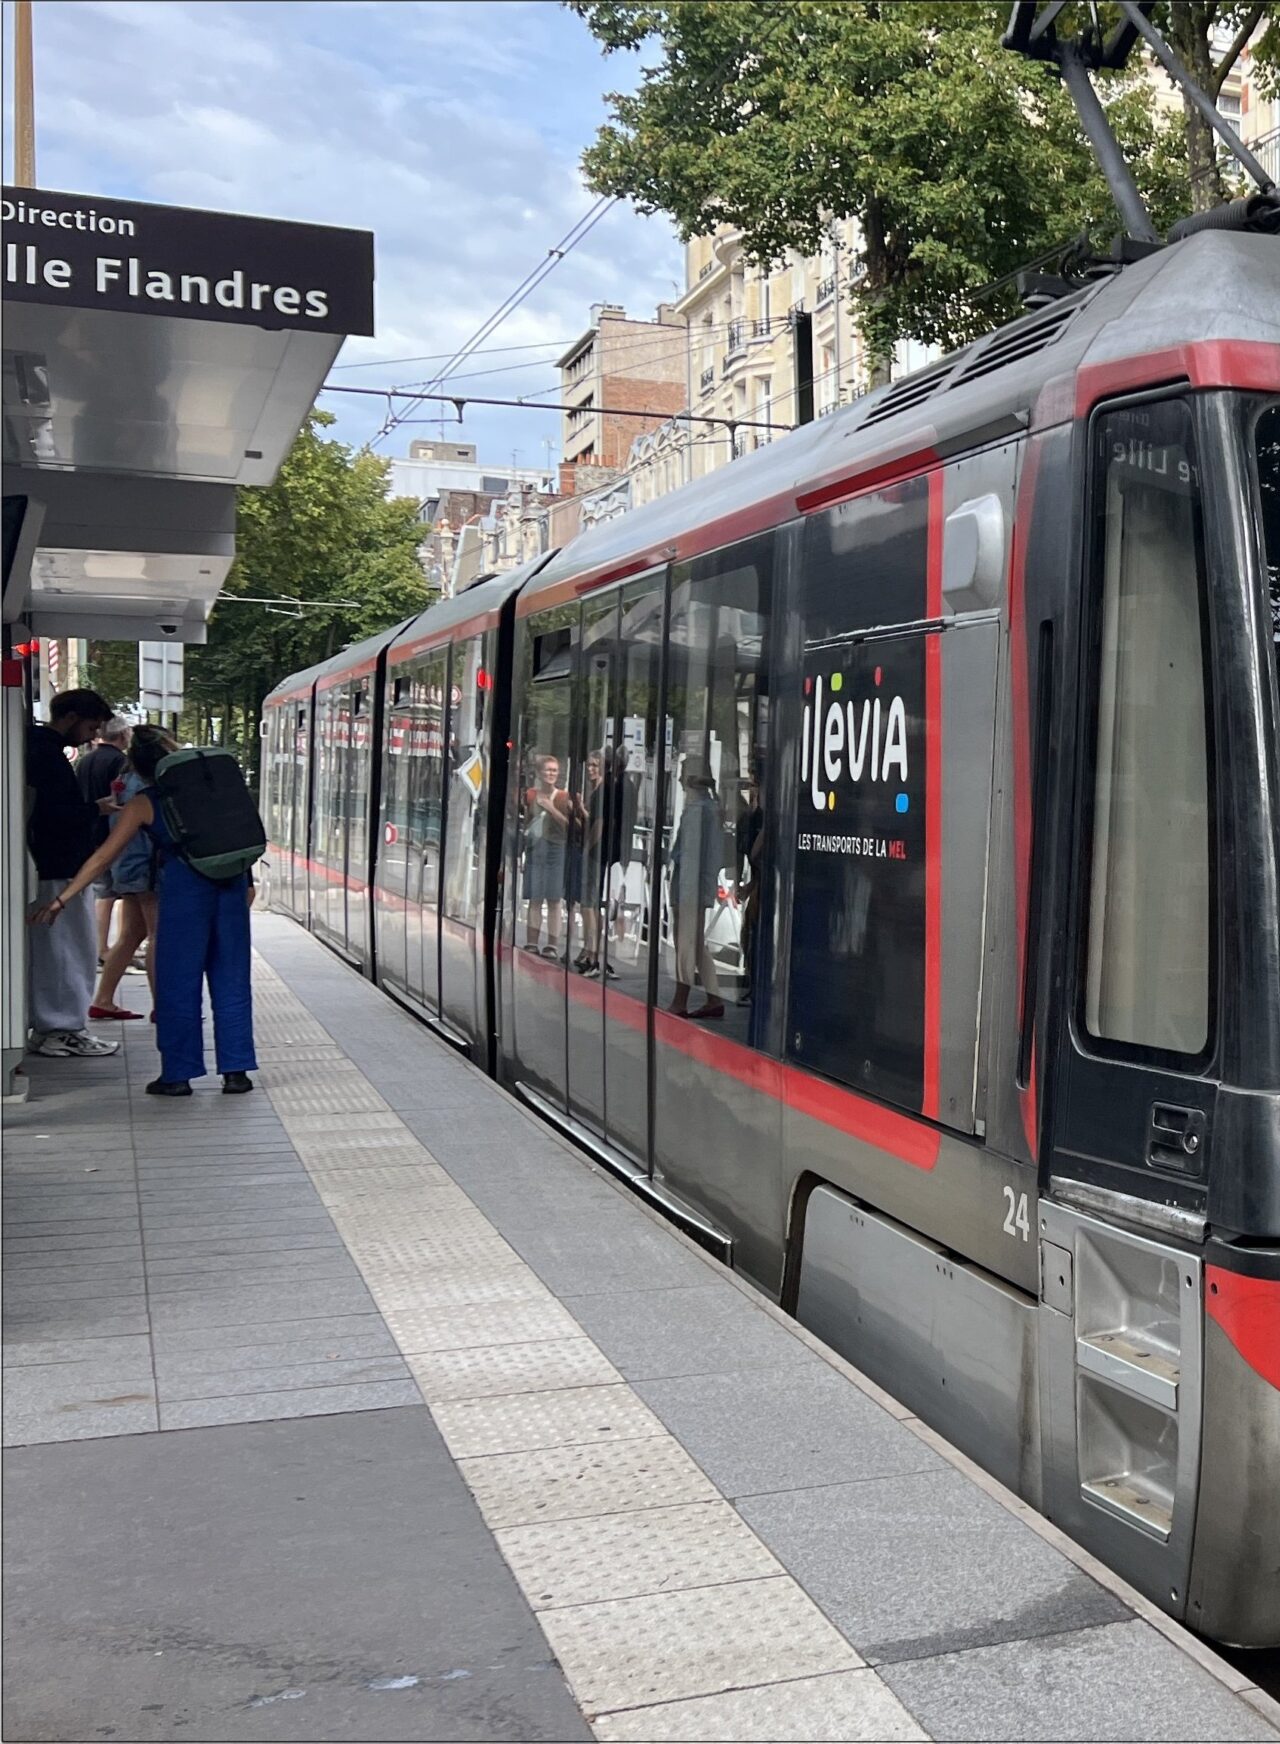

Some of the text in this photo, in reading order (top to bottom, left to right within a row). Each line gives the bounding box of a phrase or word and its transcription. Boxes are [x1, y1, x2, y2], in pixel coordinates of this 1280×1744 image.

[2, 200, 135, 236] Direction
[96, 257, 329, 318] Flandres
[798, 833, 907, 860] LES TRANSPORTS DE LA MEL
[1003, 1185, 1030, 1242] 24
